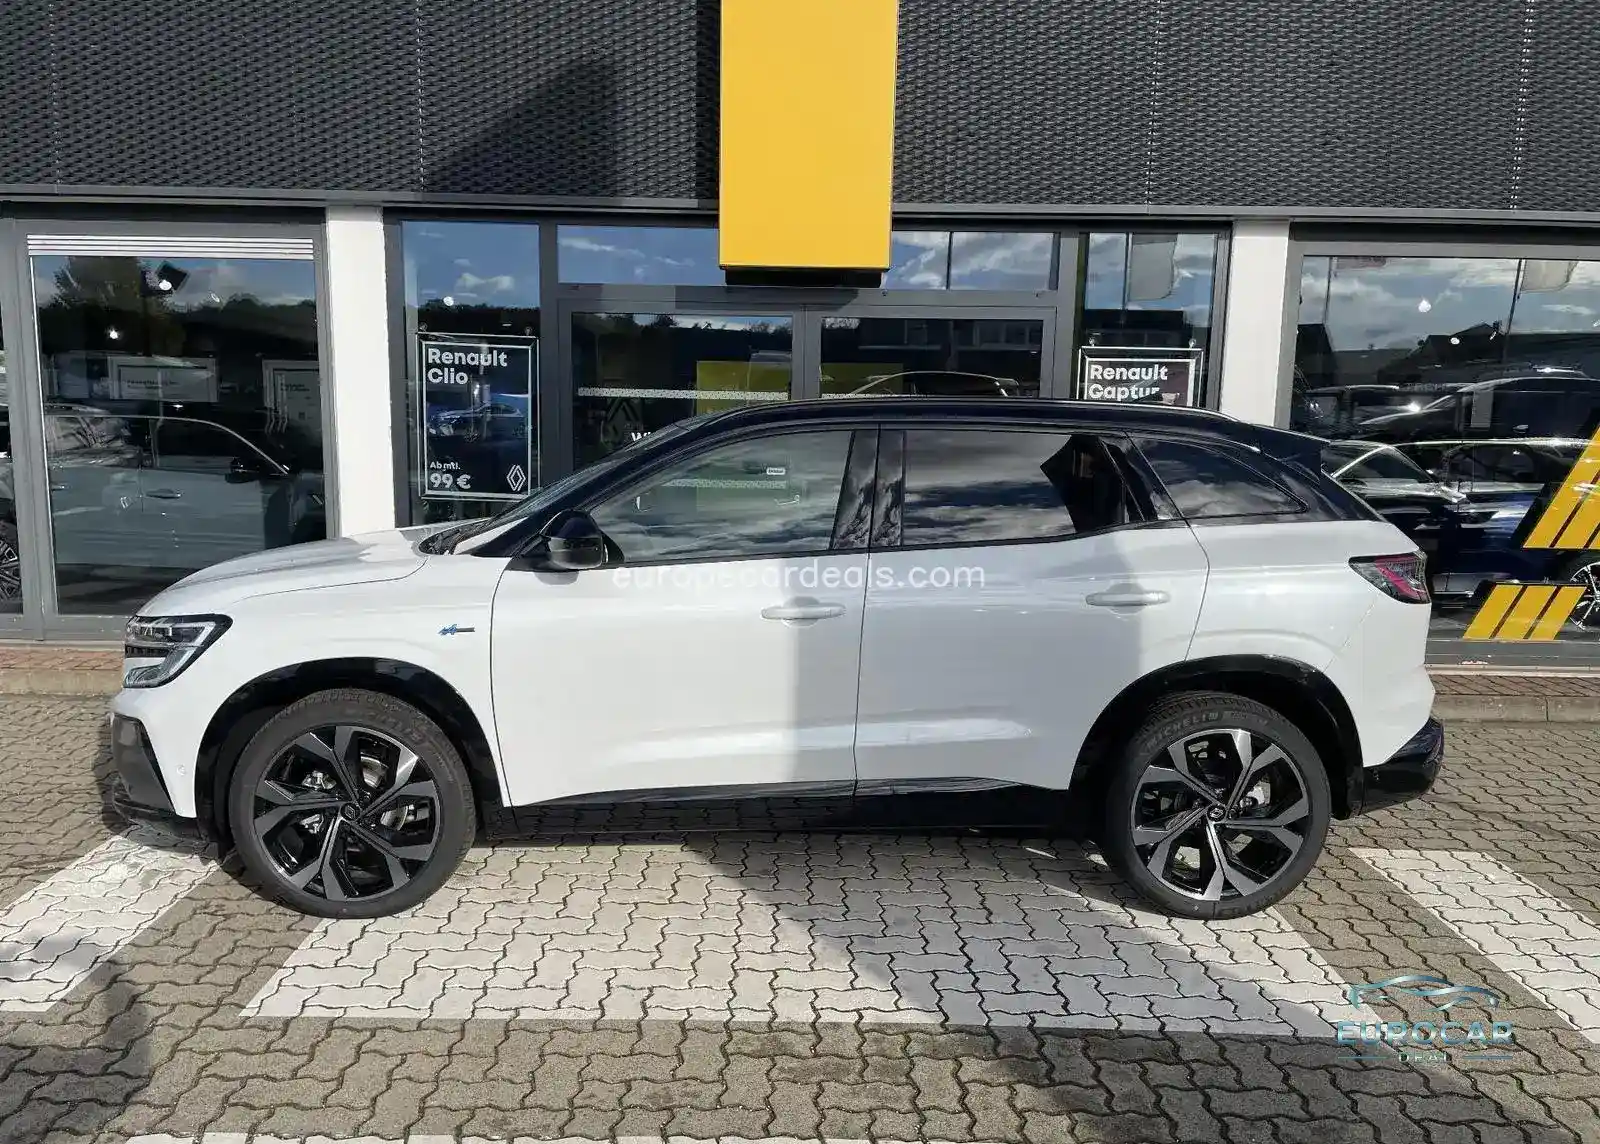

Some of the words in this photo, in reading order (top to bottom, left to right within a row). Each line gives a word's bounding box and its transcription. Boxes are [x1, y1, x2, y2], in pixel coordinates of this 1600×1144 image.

[427, 348, 508, 367] Renault
[427, 367, 469, 385] Clio
[1090, 364, 1168, 380] Renault
[1088, 383, 1161, 402] Captur
[430, 461, 442, 469] Ab
[430, 473, 453, 488] 99
[456, 474, 471, 489] €
